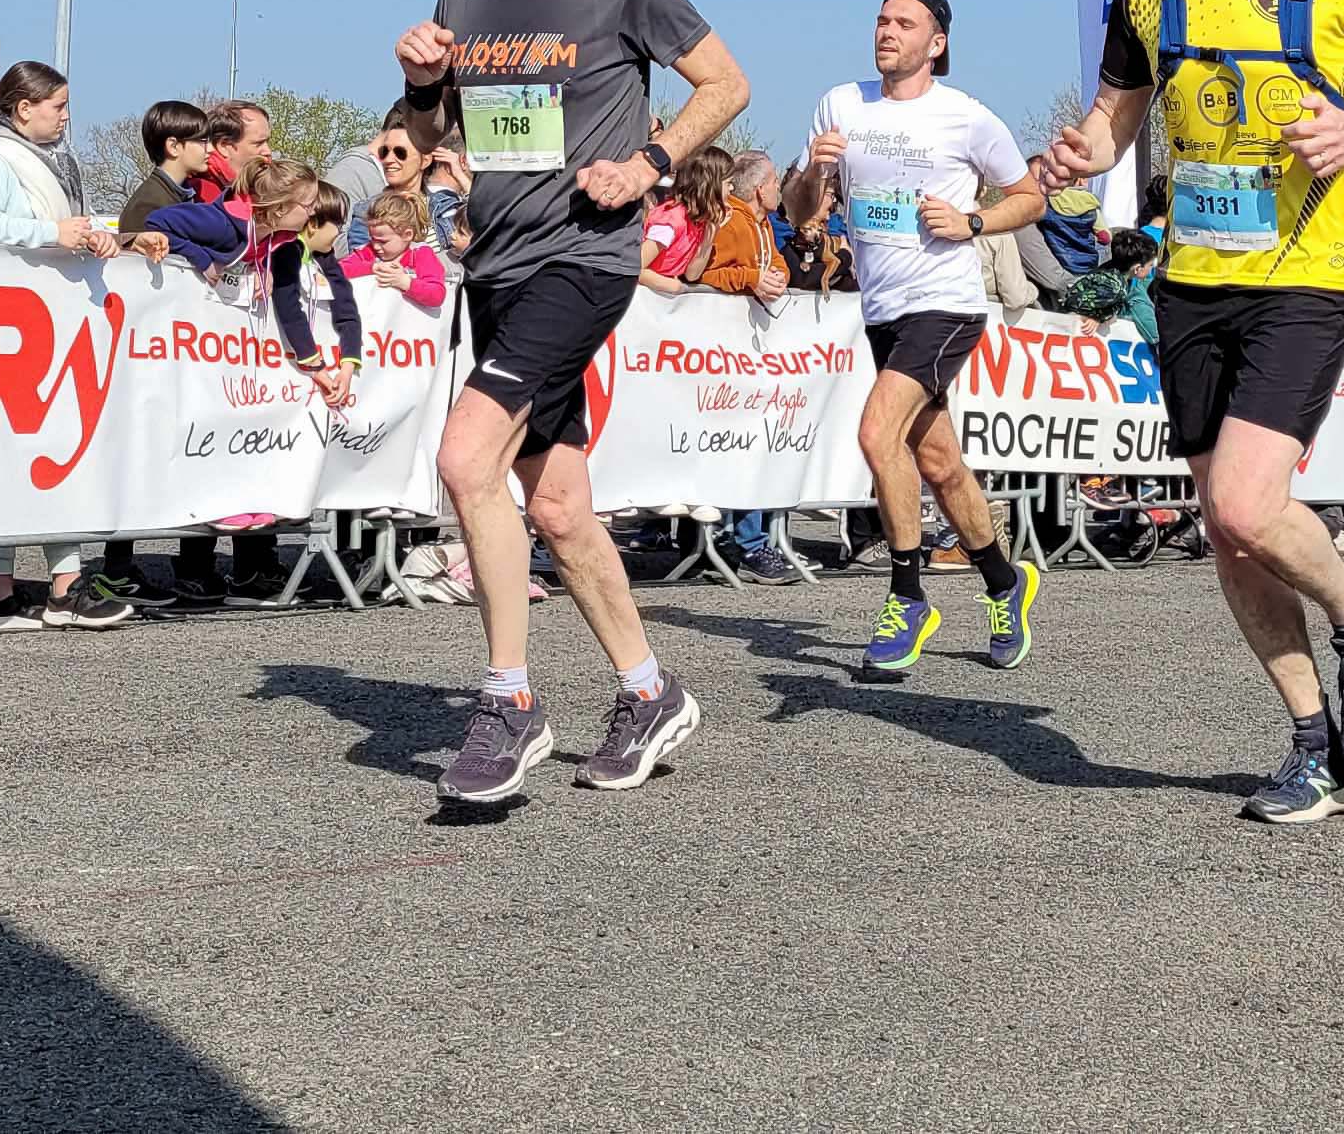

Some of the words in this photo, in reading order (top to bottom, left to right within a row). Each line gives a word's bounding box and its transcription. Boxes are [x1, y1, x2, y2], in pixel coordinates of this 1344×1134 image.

[1204, 93, 1216, 108] B
[1216, 96, 1225, 105] &
[1226, 92, 1237, 106] B
[1268, 88, 1295, 101] CM
[491, 116, 530, 136] 1768
[893, 131, 911, 145] de
[867, 205, 899, 221] 2659
[1196, 195, 1240, 216] 3131
[128, 328, 167, 359] La
[172, 321, 436, 369] Roche-u-Yon
[623, 345, 650, 372] La
[656, 340, 853, 375] Roche-sur-Yon
[222, 375, 275, 408] Ville
[281, 381, 303, 403] et
[697, 383, 739, 413] Ville
[743, 388, 763, 410] et
[763, 384, 808, 428] Agglo
[185, 421, 216, 457] Le
[670, 423, 691, 454] Le
[962, 411, 1099, 460] ROCHE
